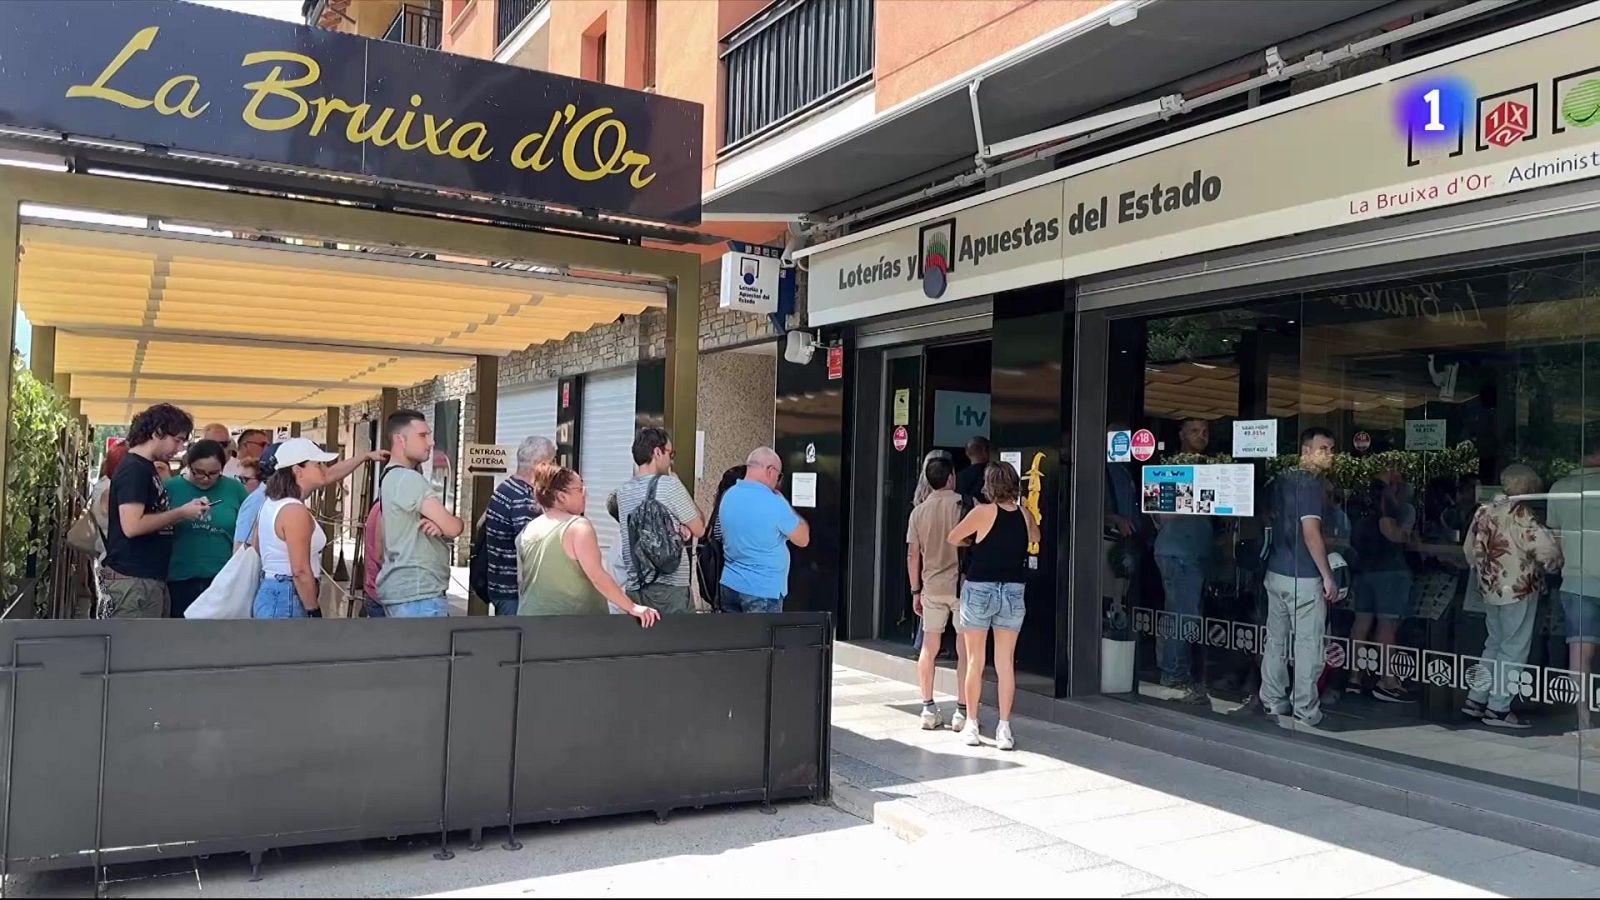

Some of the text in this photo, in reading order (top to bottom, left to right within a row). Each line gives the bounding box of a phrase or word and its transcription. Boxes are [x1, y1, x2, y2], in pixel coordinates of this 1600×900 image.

[66, 26, 657, 190] La Bruixa d'Or
[1350, 151, 1600, 215] La Bruixa d'Or Administ
[839, 170, 1222, 289] Loterías y Apuestas del Estado
[470, 448, 506, 456] ENTRADA
[1136, 432, 1150, 443] +18
